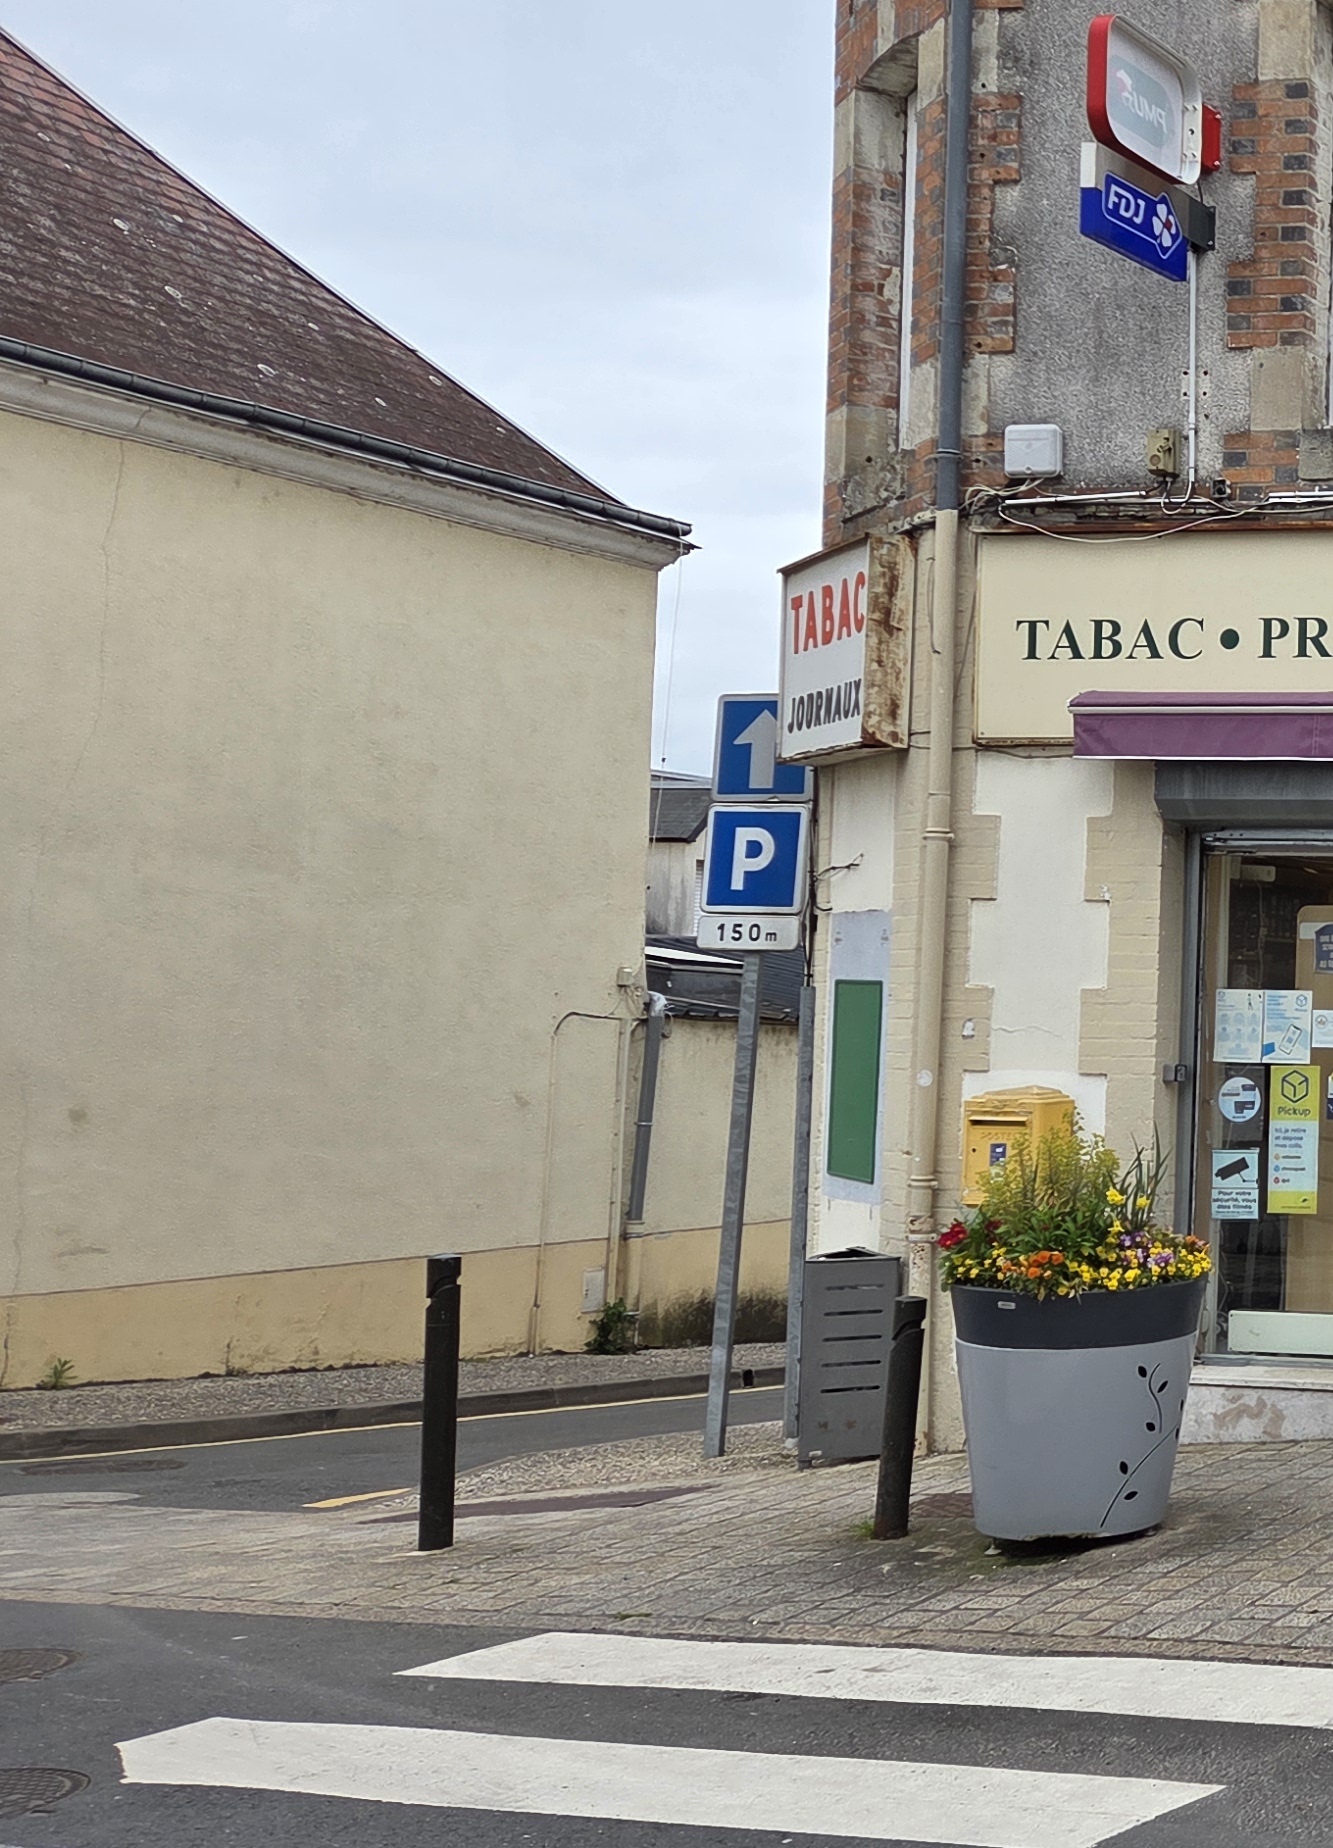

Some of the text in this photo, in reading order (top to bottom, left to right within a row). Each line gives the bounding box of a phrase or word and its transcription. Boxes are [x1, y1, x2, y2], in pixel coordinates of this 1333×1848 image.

[1107, 184, 1146, 225] FDJ
[791, 571, 866, 654] TABAC
[1015, 616, 1206, 661] TABAC
[787, 677, 862, 734] JOURNAUX
[729, 826, 776, 891] P
[1277, 1106, 1312, 1118] Pickup
